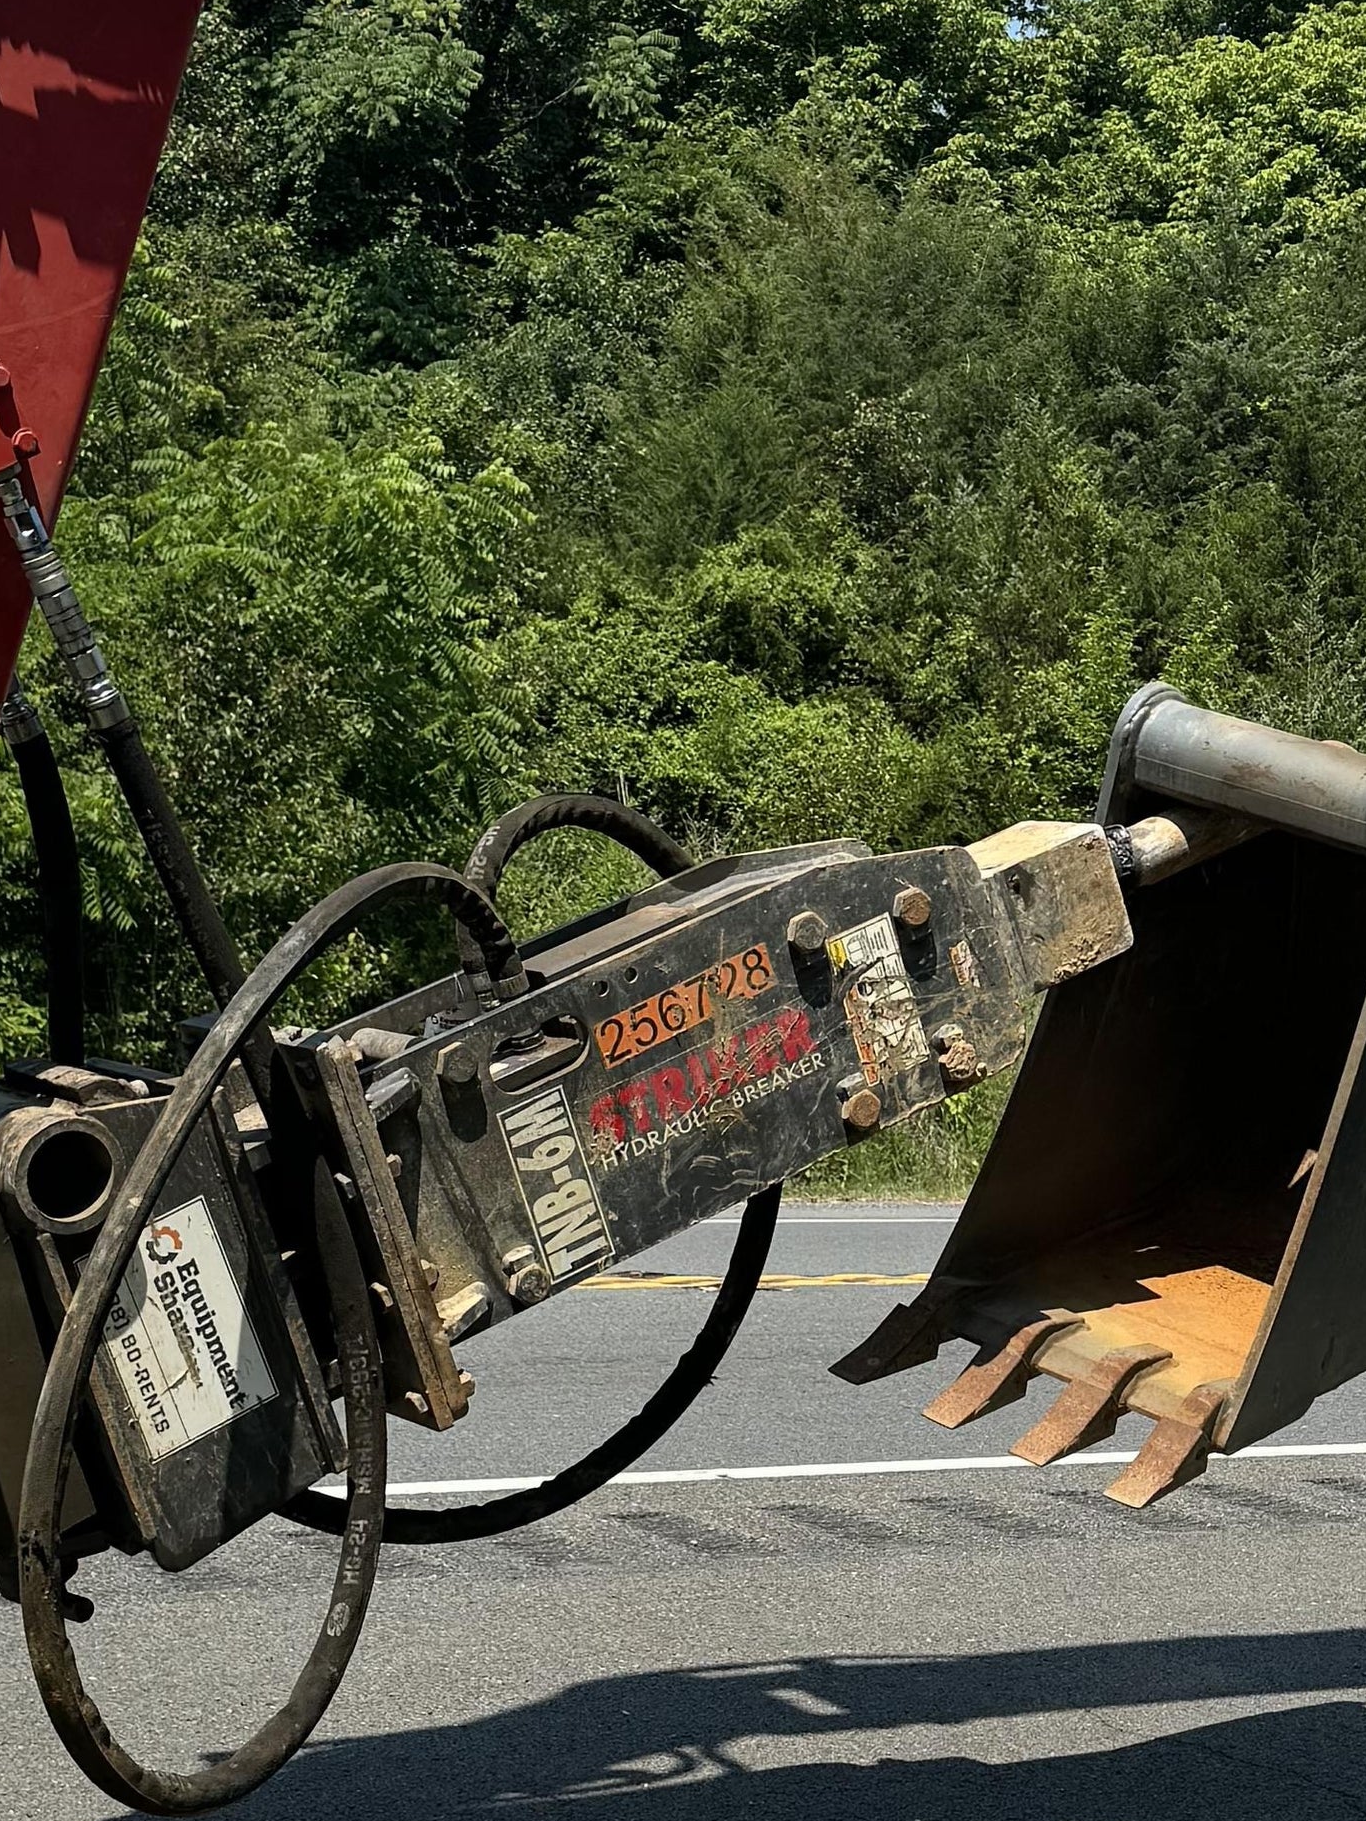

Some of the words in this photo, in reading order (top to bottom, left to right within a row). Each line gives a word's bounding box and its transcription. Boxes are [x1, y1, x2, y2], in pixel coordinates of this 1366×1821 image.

[731, 1052, 827, 1110] BREAKER
[504, 1090, 610, 1277] TNB-6M
[176, 1257, 247, 1410] Equipment
